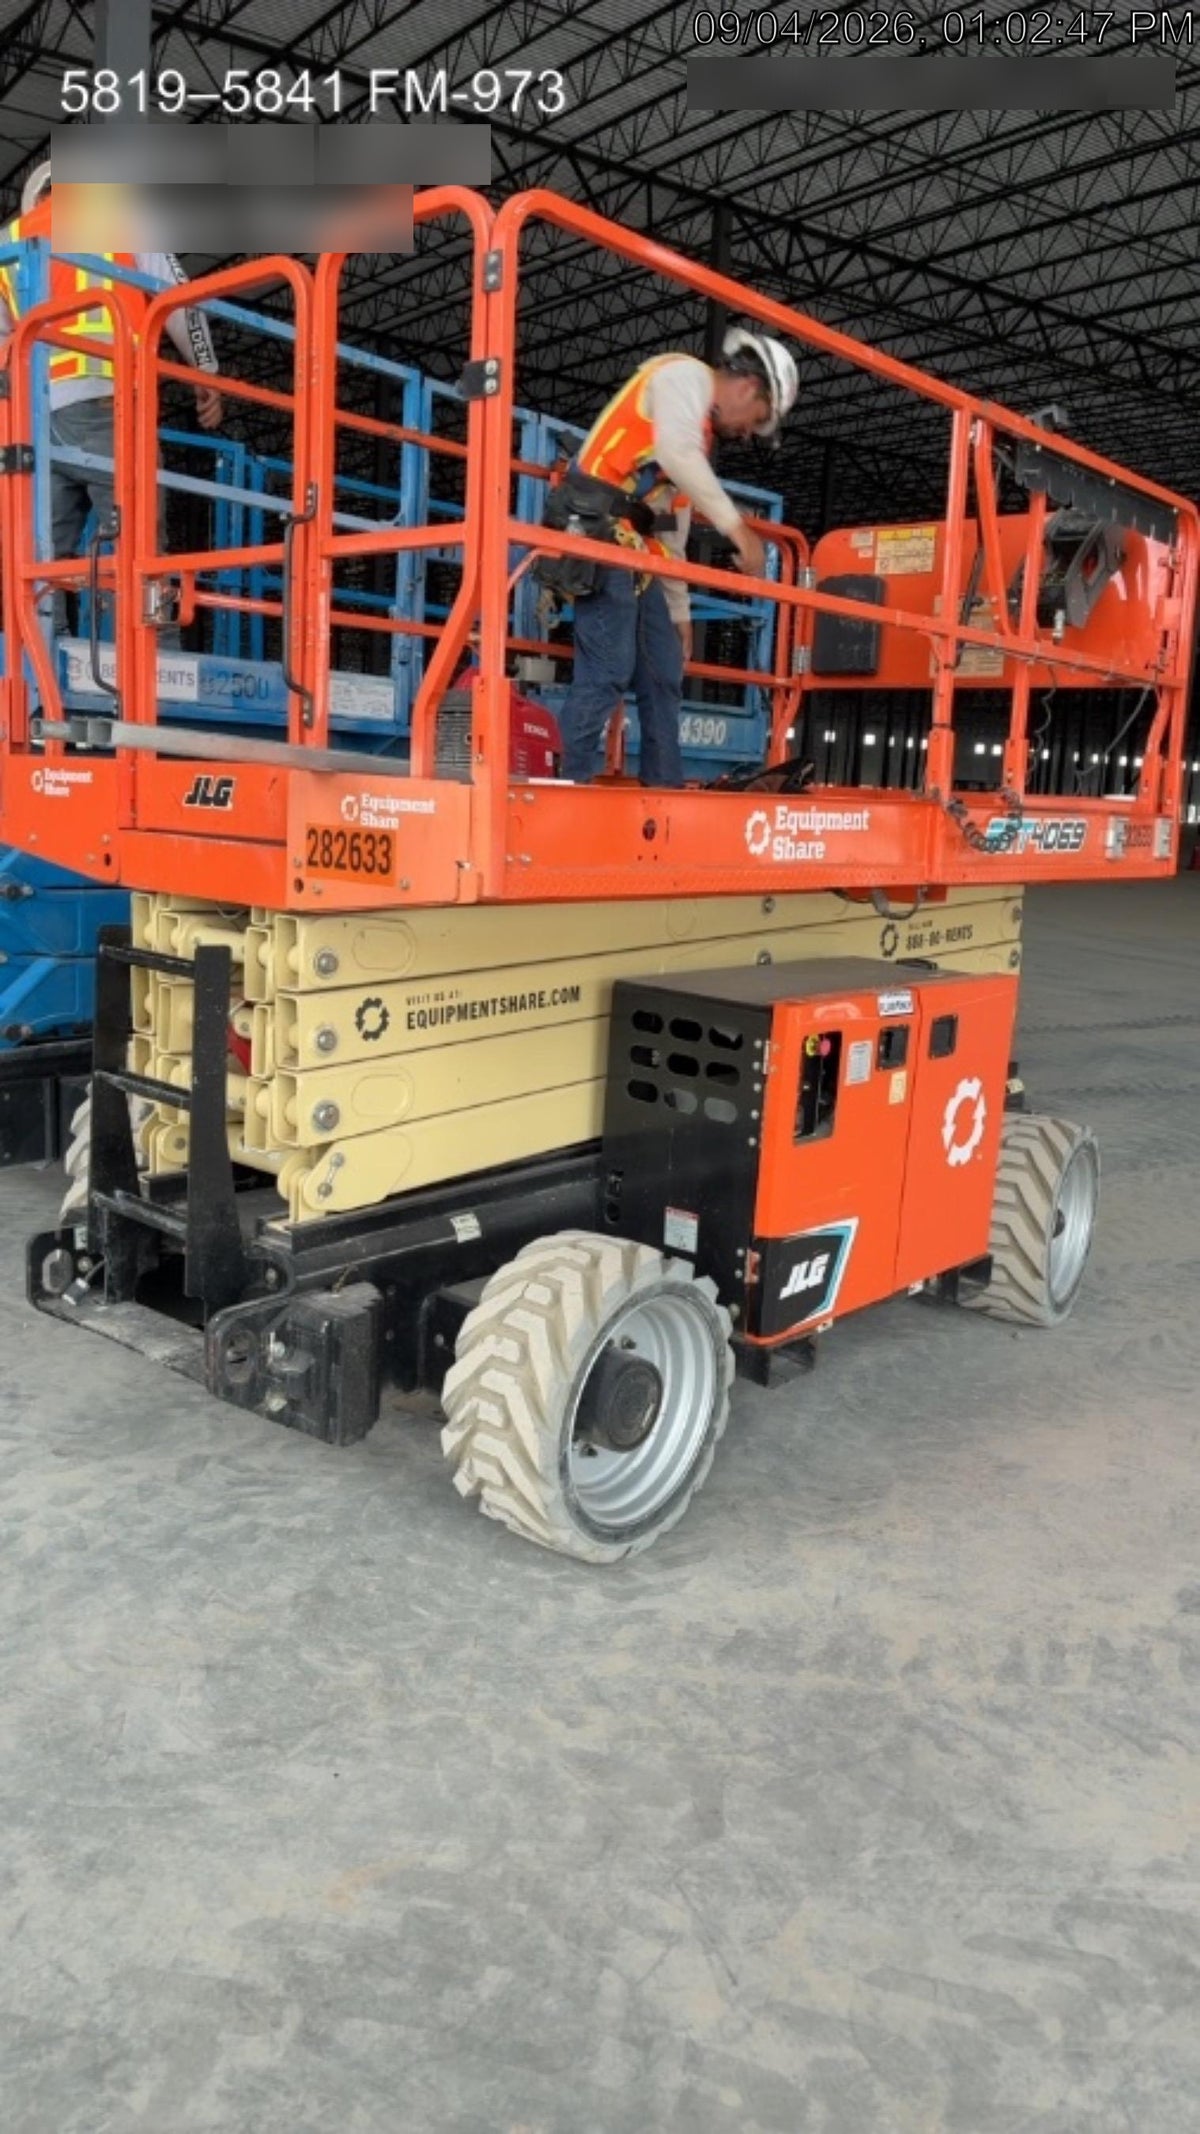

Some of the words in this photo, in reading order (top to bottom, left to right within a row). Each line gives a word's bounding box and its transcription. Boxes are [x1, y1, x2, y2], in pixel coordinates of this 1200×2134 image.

[184, 775, 234, 810] JLG
[361, 793, 437, 814] Equipment
[360, 811, 399, 830] Share
[774, 805, 870, 836] Equipment
[307, 827, 392, 875] 282633
[772, 835, 825, 861] Share
[407, 985, 581, 1031] EQUIPMENTSHARE.COM
[779, 1252, 831, 1300] JLG
